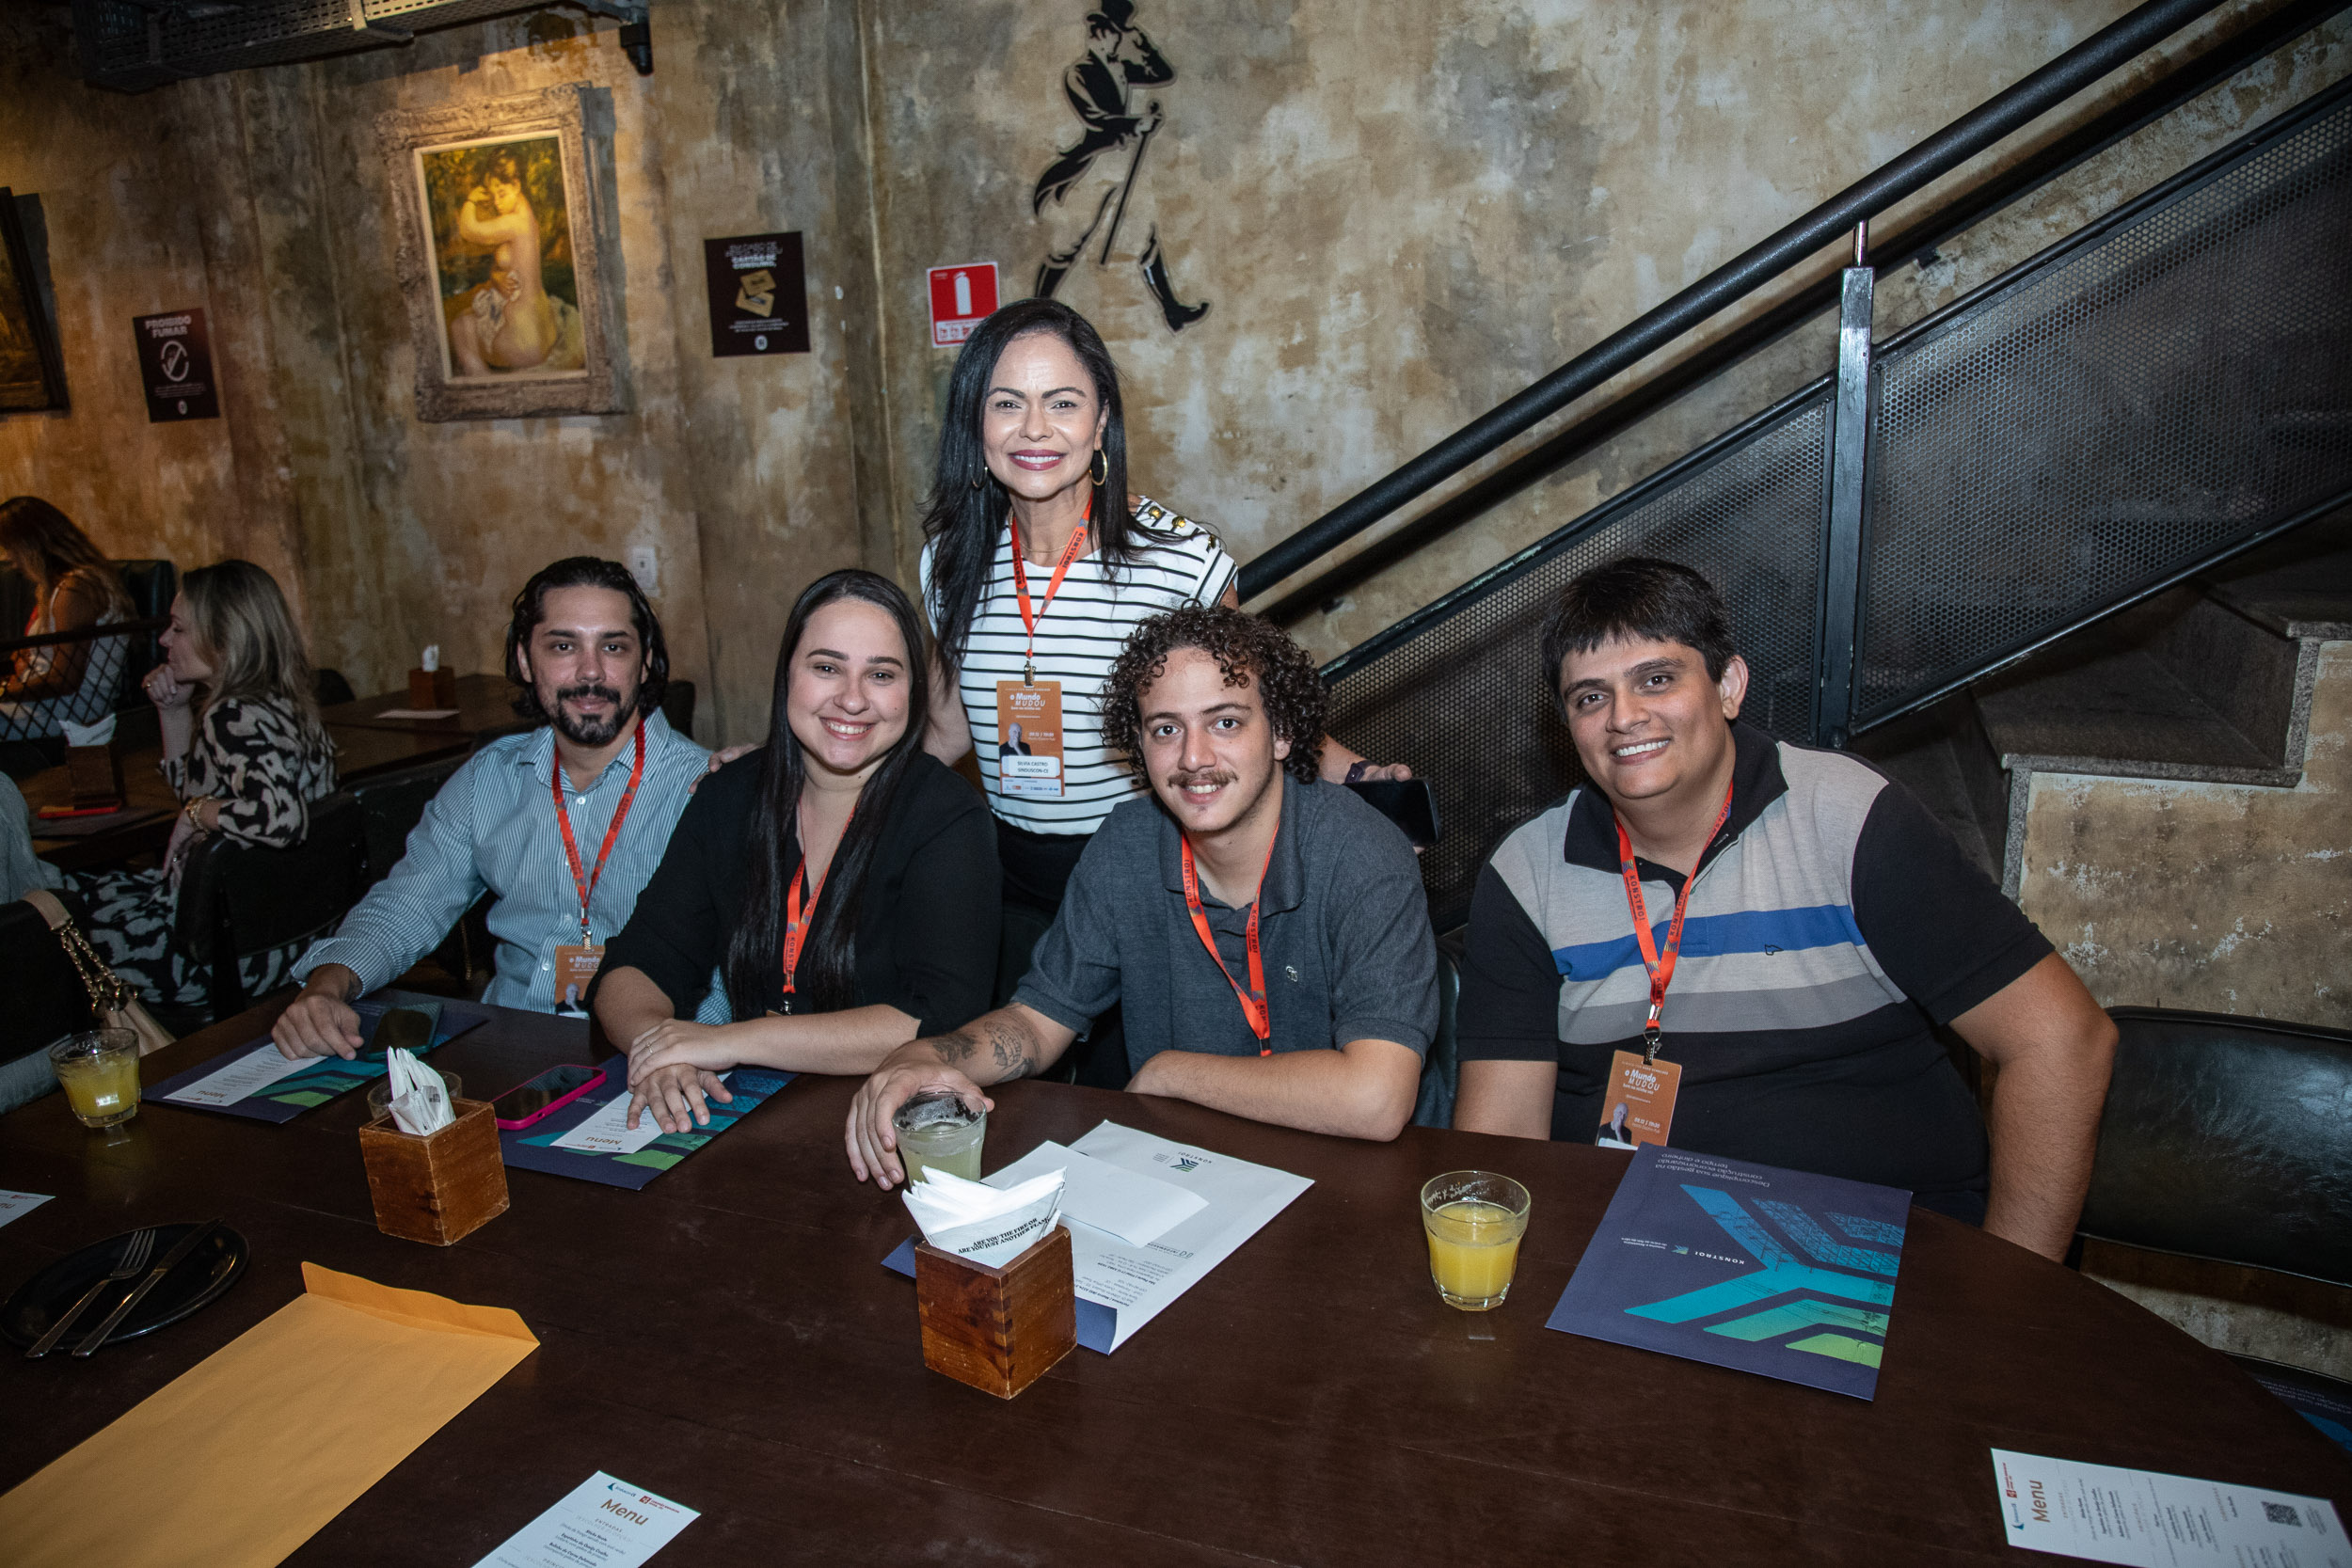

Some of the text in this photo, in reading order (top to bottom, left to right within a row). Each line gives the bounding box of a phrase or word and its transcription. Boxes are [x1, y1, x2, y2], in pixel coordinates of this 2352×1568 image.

[145, 315, 192, 330] PROIBIDO
[152, 325, 187, 339] FUMAR
[1063, 531, 1085, 569] KONSTROI
[1016, 692, 1041, 701] Mundo
[1184, 859, 1193, 903] KONSTROI
[1629, 875, 1645, 921] KONSTROI
[1669, 890, 1685, 936] KONSTROI
[1630, 1069, 1656, 1083] Mundo
[1629, 1077, 1660, 1091] MUDOU
[585, 1136, 622, 1145] Menu
[1178, 1151, 1213, 1164] KONSTROI
[1661, 1152, 1693, 1162] dinheiro
[1666, 1164, 1695, 1173] gestão
[1701, 1160, 1728, 1169] tempo
[1711, 1172, 1771, 1187] Descomplique
[1717, 1167, 1763, 1180] construção
[973, 1237, 985, 1247] ARE
[999, 1230, 1013, 1239] THE
[1013, 1224, 1027, 1234] FIRE
[1027, 1217, 1038, 1226] OR
[971, 1243, 985, 1252] YOU
[985, 1240, 1001, 1249] JUST
[1000, 1227, 1030, 1244] ANOTHER
[1694, 1251, 1745, 1265] KONSTROI
[2029, 1480, 2051, 1523] Menu
[600, 1498, 649, 1526] Menu
